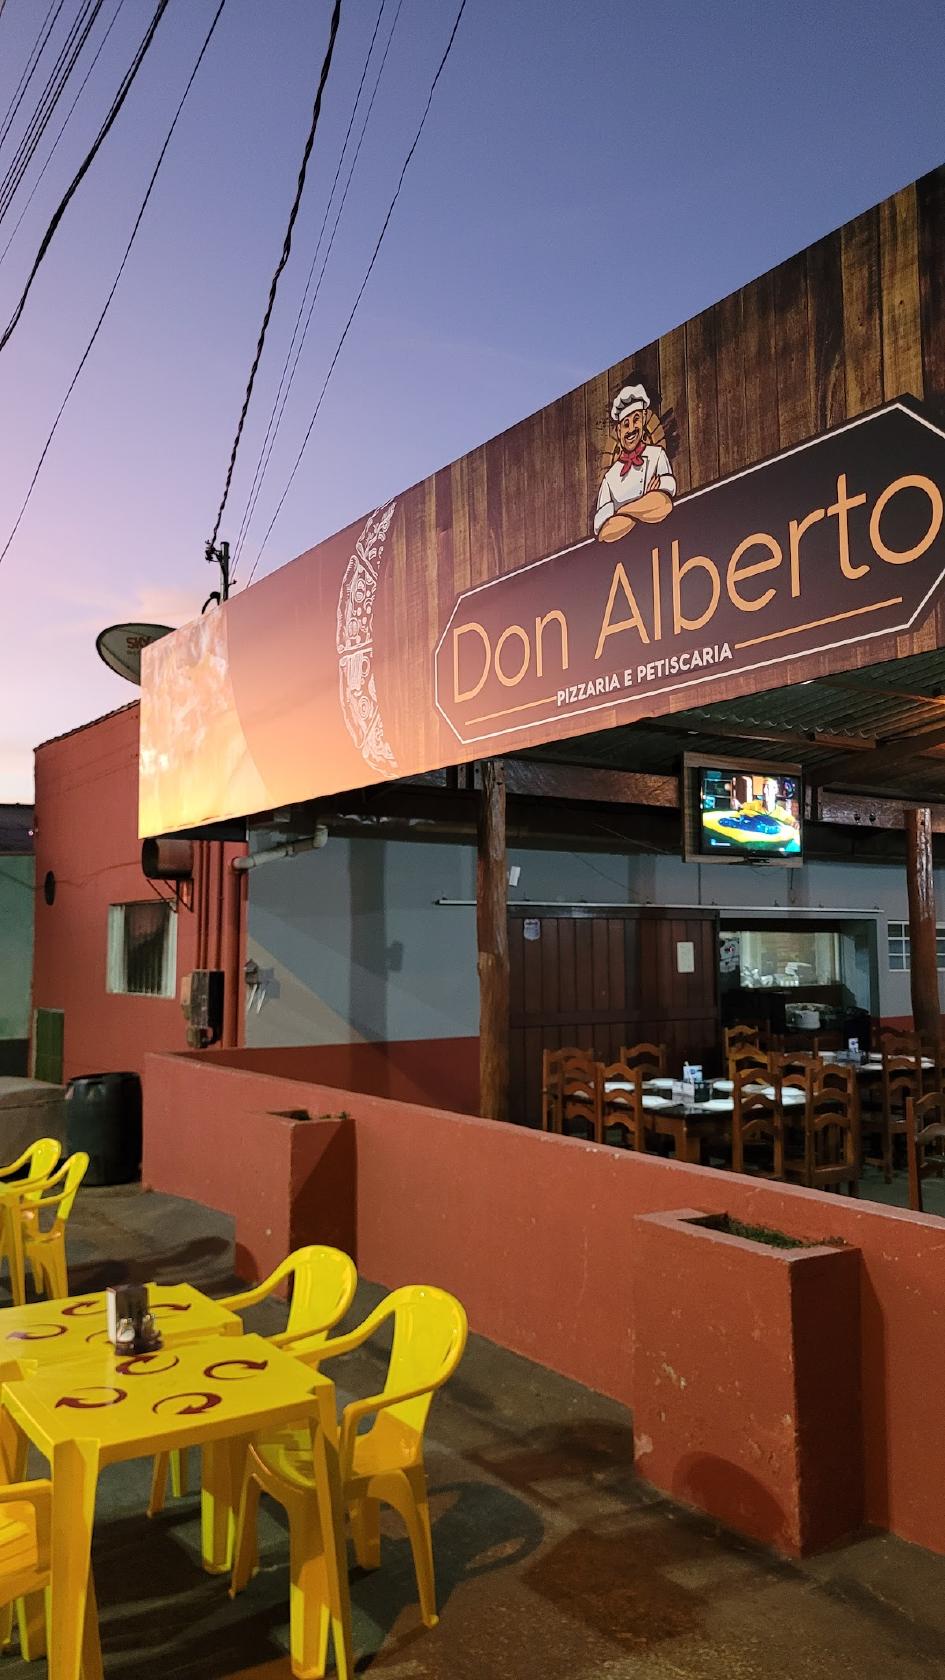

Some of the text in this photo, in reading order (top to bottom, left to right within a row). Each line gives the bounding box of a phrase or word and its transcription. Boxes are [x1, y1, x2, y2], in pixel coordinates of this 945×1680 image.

[452, 472, 943, 703] Don Alberto
[557, 642, 733, 706] PIZZARIA E PETISCARIA
